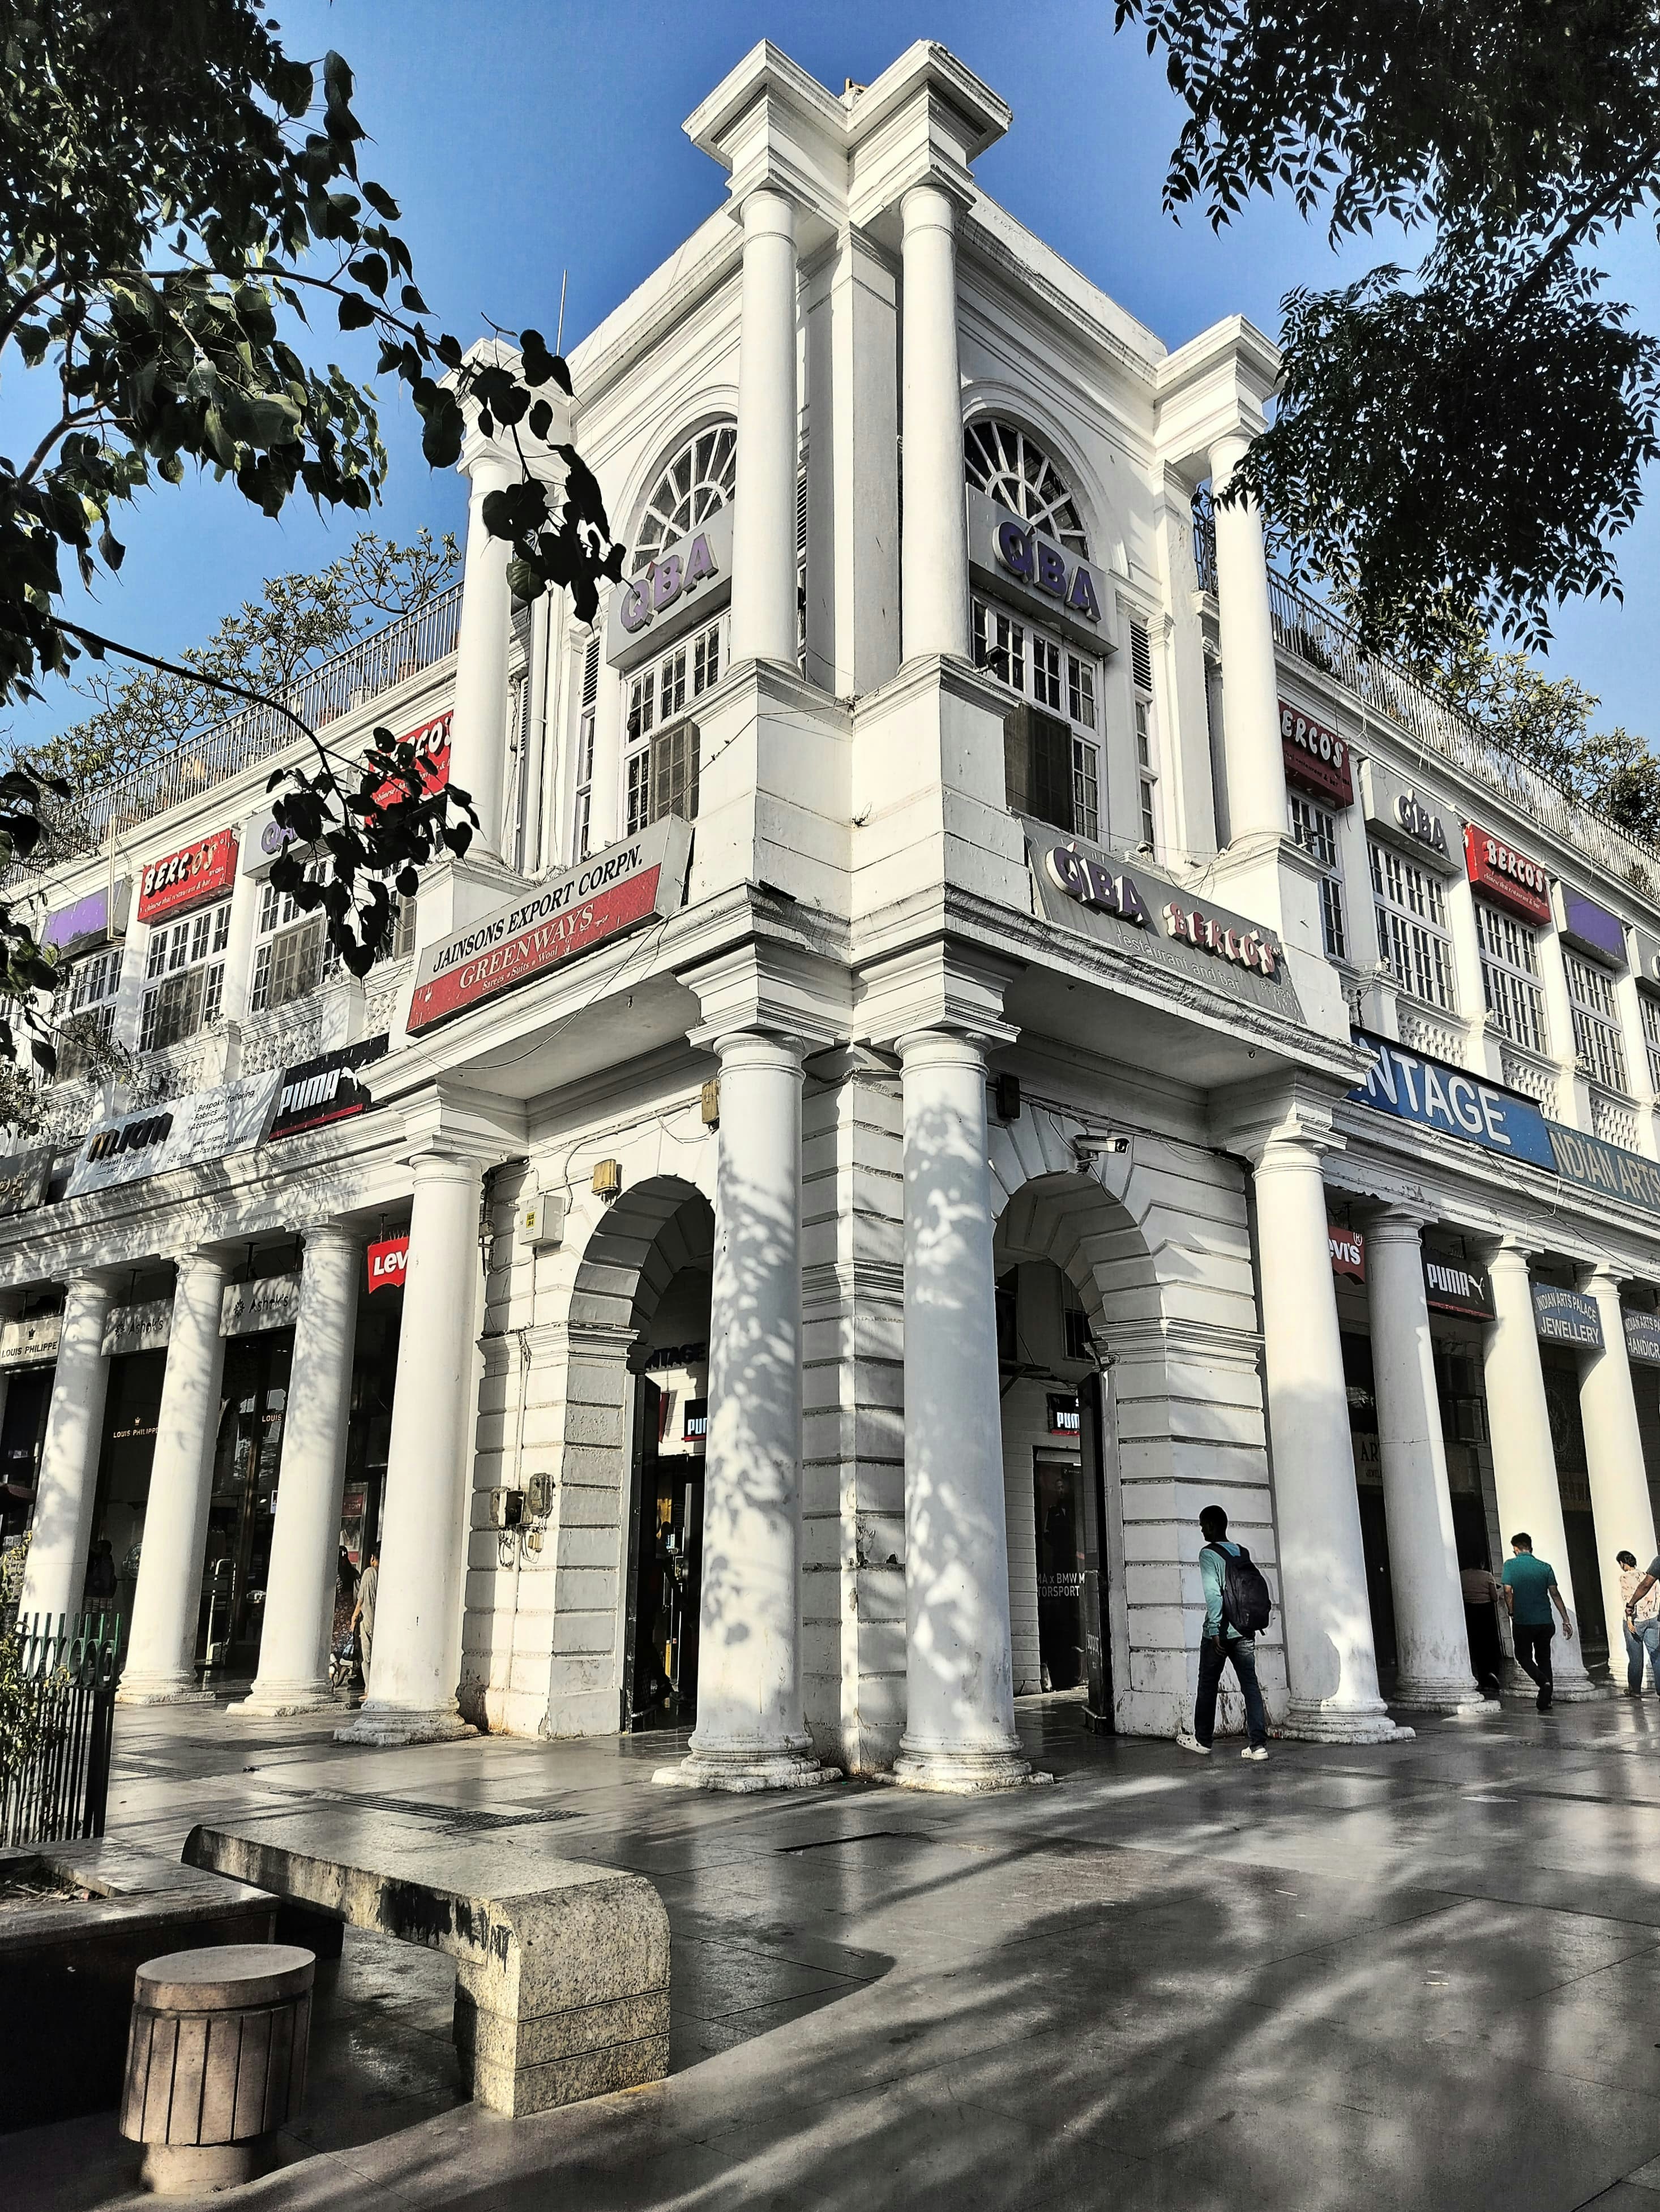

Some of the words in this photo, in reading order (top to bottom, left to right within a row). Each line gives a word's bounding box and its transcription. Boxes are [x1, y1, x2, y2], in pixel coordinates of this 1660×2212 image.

[621, 533, 719, 634] QBA
[992, 521, 1102, 623] QBA
[1393, 788, 1449, 855] QBA
[143, 843, 219, 898] BERCO'S
[1484, 839, 1543, 893] BERCO'S
[433, 919, 504, 973] JAINSONS
[507, 880, 574, 934] EXPORT
[578, 844, 643, 897] CORPN.
[1046, 842, 1153, 928] QBA
[1162, 902, 1276, 974] BERCO'S
[459, 903, 594, 989] GREENWAYS
[1116, 924, 1190, 971] restaurant
[1192, 962, 1216, 983] and
[1218, 969, 1240, 991] bar
[482, 975, 504, 991] Sarees
[511, 962, 529, 978] Suits
[198, 1099, 225, 1112] Bespoke
[226, 1090, 255, 1103] Tailoring
[277, 1069, 340, 1117] PUMA
[1358, 1037, 1512, 1146] NTAGE
[190, 1114, 229, 1131] Accessories
[194, 1109, 218, 1121] Fabrics
[1427, 1263, 1470, 1297] PUMA
[1536, 1292, 1557, 1311] INDIAN
[1556, 1292, 1572, 1309] ARTS
[1572, 1296, 1596, 1323] PALACE
[1640, 1315, 1653, 1330] ARTS
[1541, 1317, 1599, 1344] JEWELLERY
[2, 1347, 22, 1358] LOUIS
[24, 1341, 58, 1354] PHILIPPE
[113, 1430, 131, 1438] LOUIS
[1361, 1442, 1380, 1461] AR
[1038, 1586, 1080, 1597] TORSPORT
[1057, 1573, 1077, 1584] BMW
[1079, 1573, 1085, 1584] M
